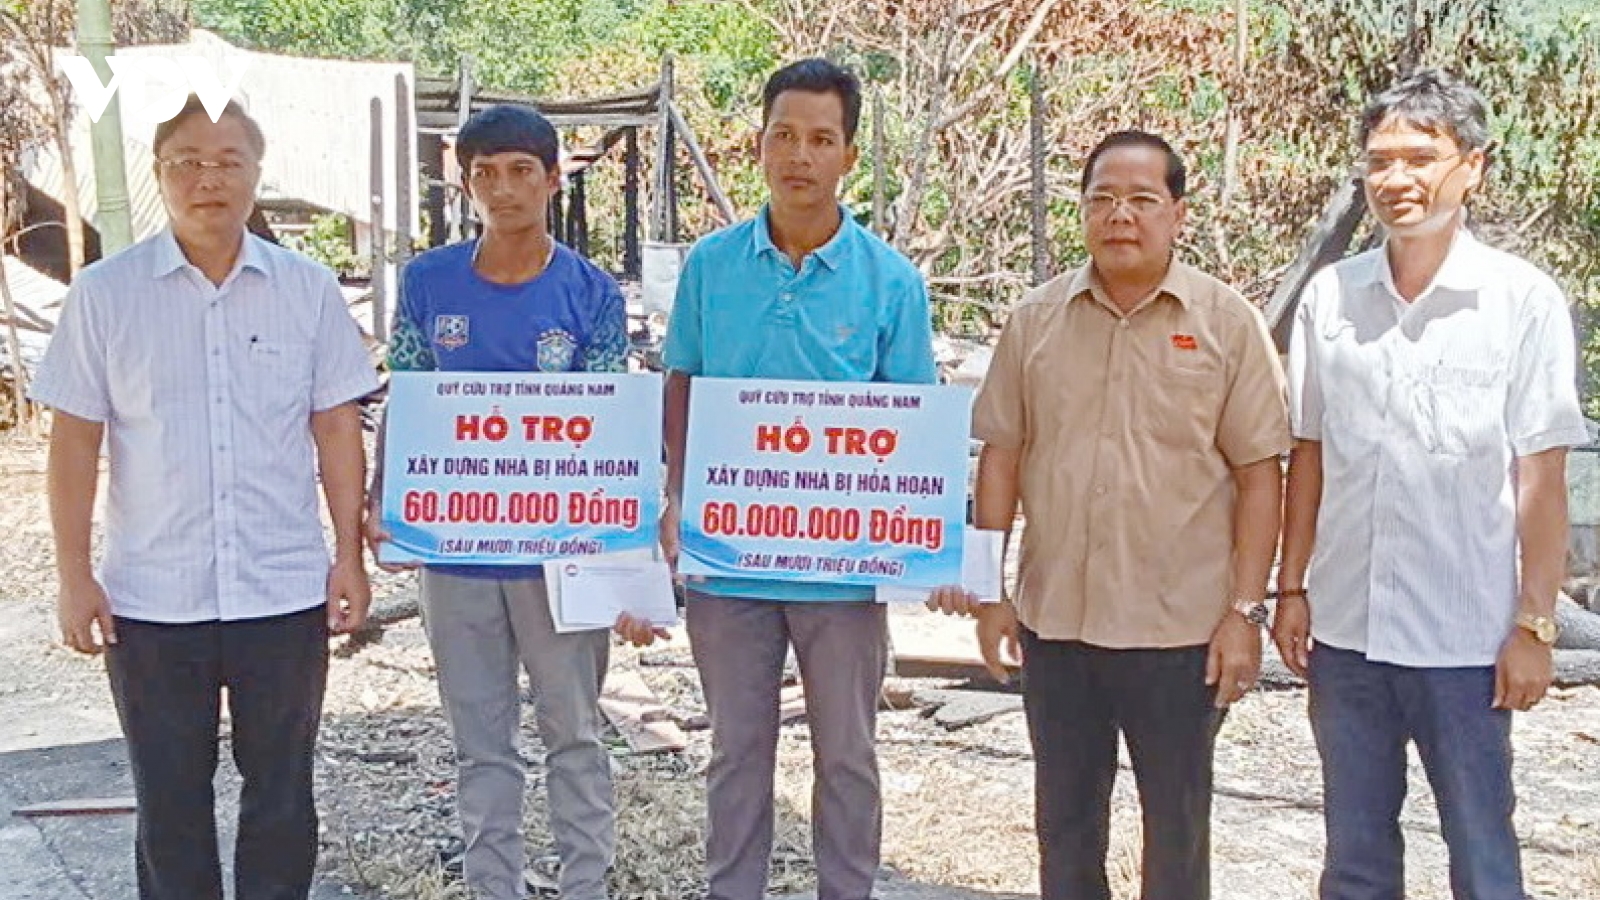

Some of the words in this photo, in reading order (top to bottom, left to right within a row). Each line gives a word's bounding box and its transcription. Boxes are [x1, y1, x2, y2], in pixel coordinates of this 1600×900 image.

[490, 382, 512, 397] TRỢ
[587, 383, 615, 396] NAM
[793, 391, 815, 407] TRỢ
[891, 395, 921, 409] NAM
[456, 405, 510, 441] HỖ
[521, 415, 594, 449] TRỢ
[756, 415, 811, 453] HỖ
[824, 427, 899, 463] TRỢ
[407, 453, 439, 476] XÂY
[444, 455, 489, 480] DỰNG
[495, 456, 529, 477] NHÀ
[534, 459, 551, 481] BỊ
[555, 453, 589, 477] HỎA
[593, 459, 639, 481] HOẠN
[706, 464, 739, 486] XÂY
[744, 467, 790, 492] DỰNG
[794, 468, 830, 490] NHÀ
[834, 472, 851, 496] BỊ
[856, 468, 891, 494] HỎA
[896, 474, 944, 499] HOẠN
[404, 490, 560, 524] 60.000.000
[568, 487, 639, 529] Đồng
[703, 501, 860, 541] 60.000.000
[869, 505, 942, 550] Đồng
